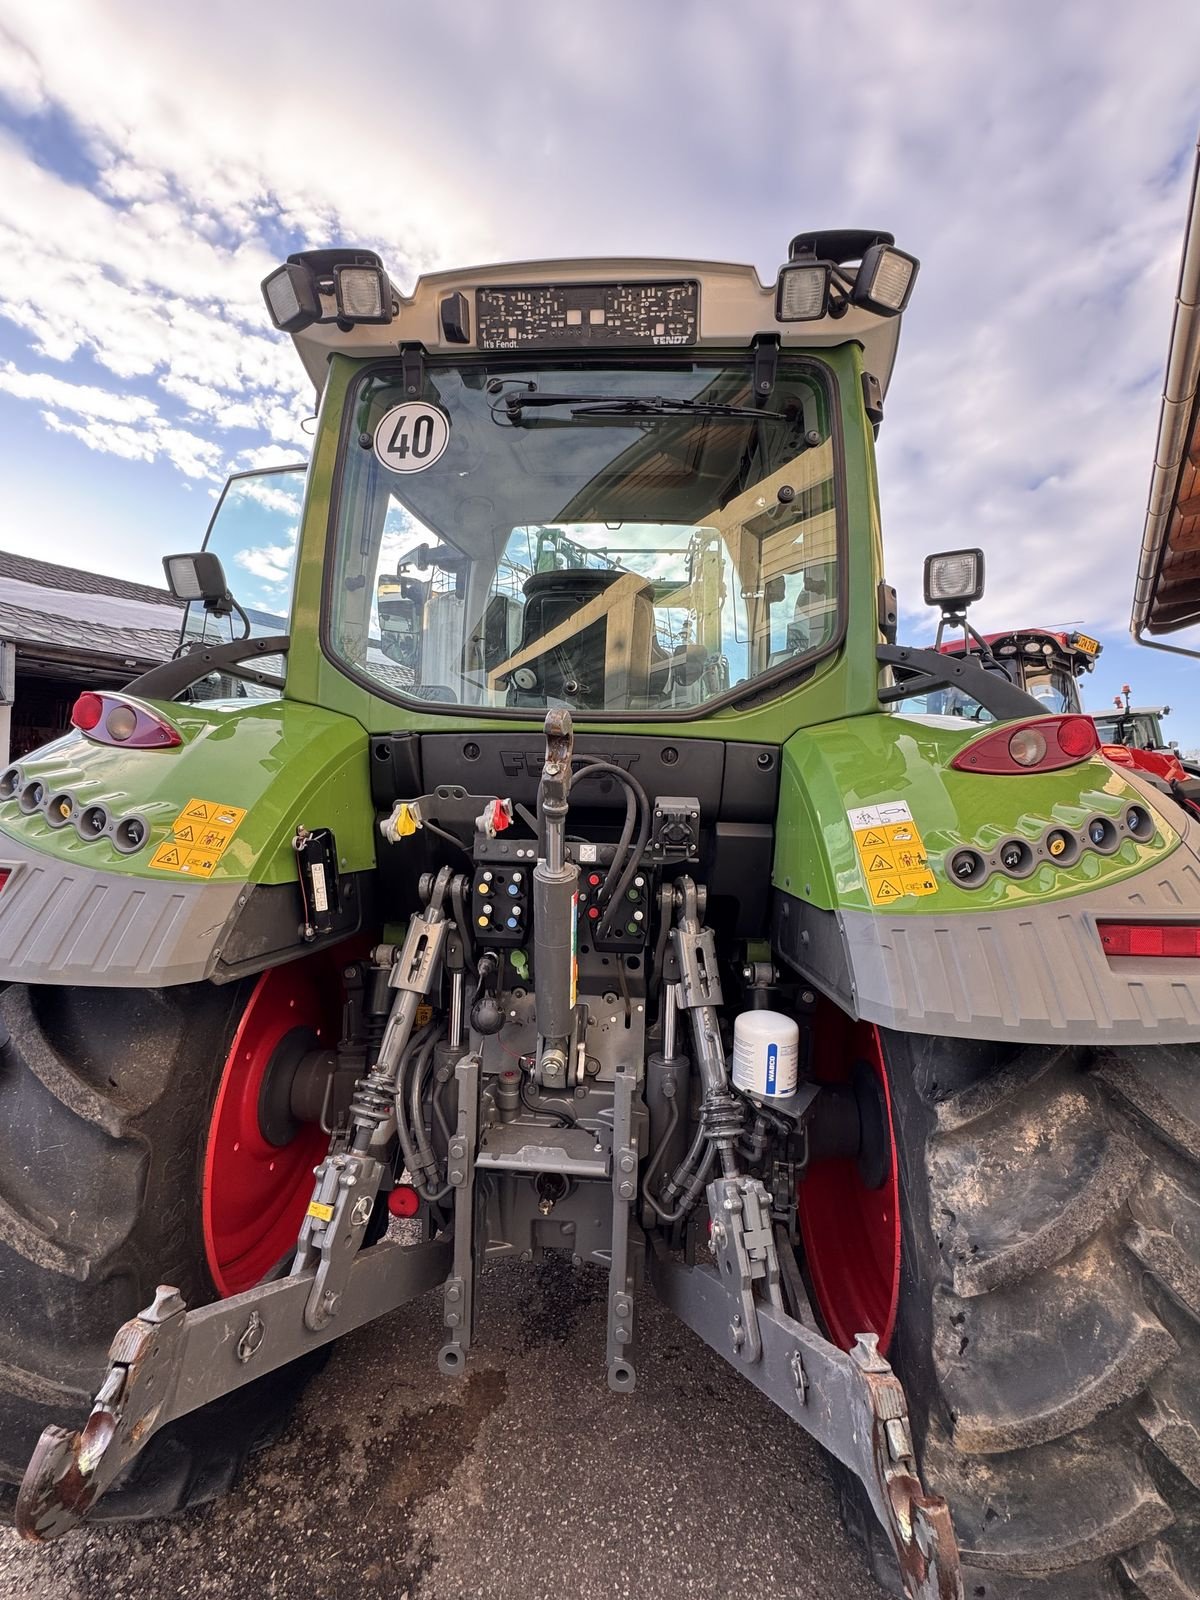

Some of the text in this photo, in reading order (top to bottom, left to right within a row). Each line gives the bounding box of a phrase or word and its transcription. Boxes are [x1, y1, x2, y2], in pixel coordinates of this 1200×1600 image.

[652, 336, 689, 345] FENDT
[387, 415, 434, 459] 40
[768, 1055, 776, 1082] WABCO
